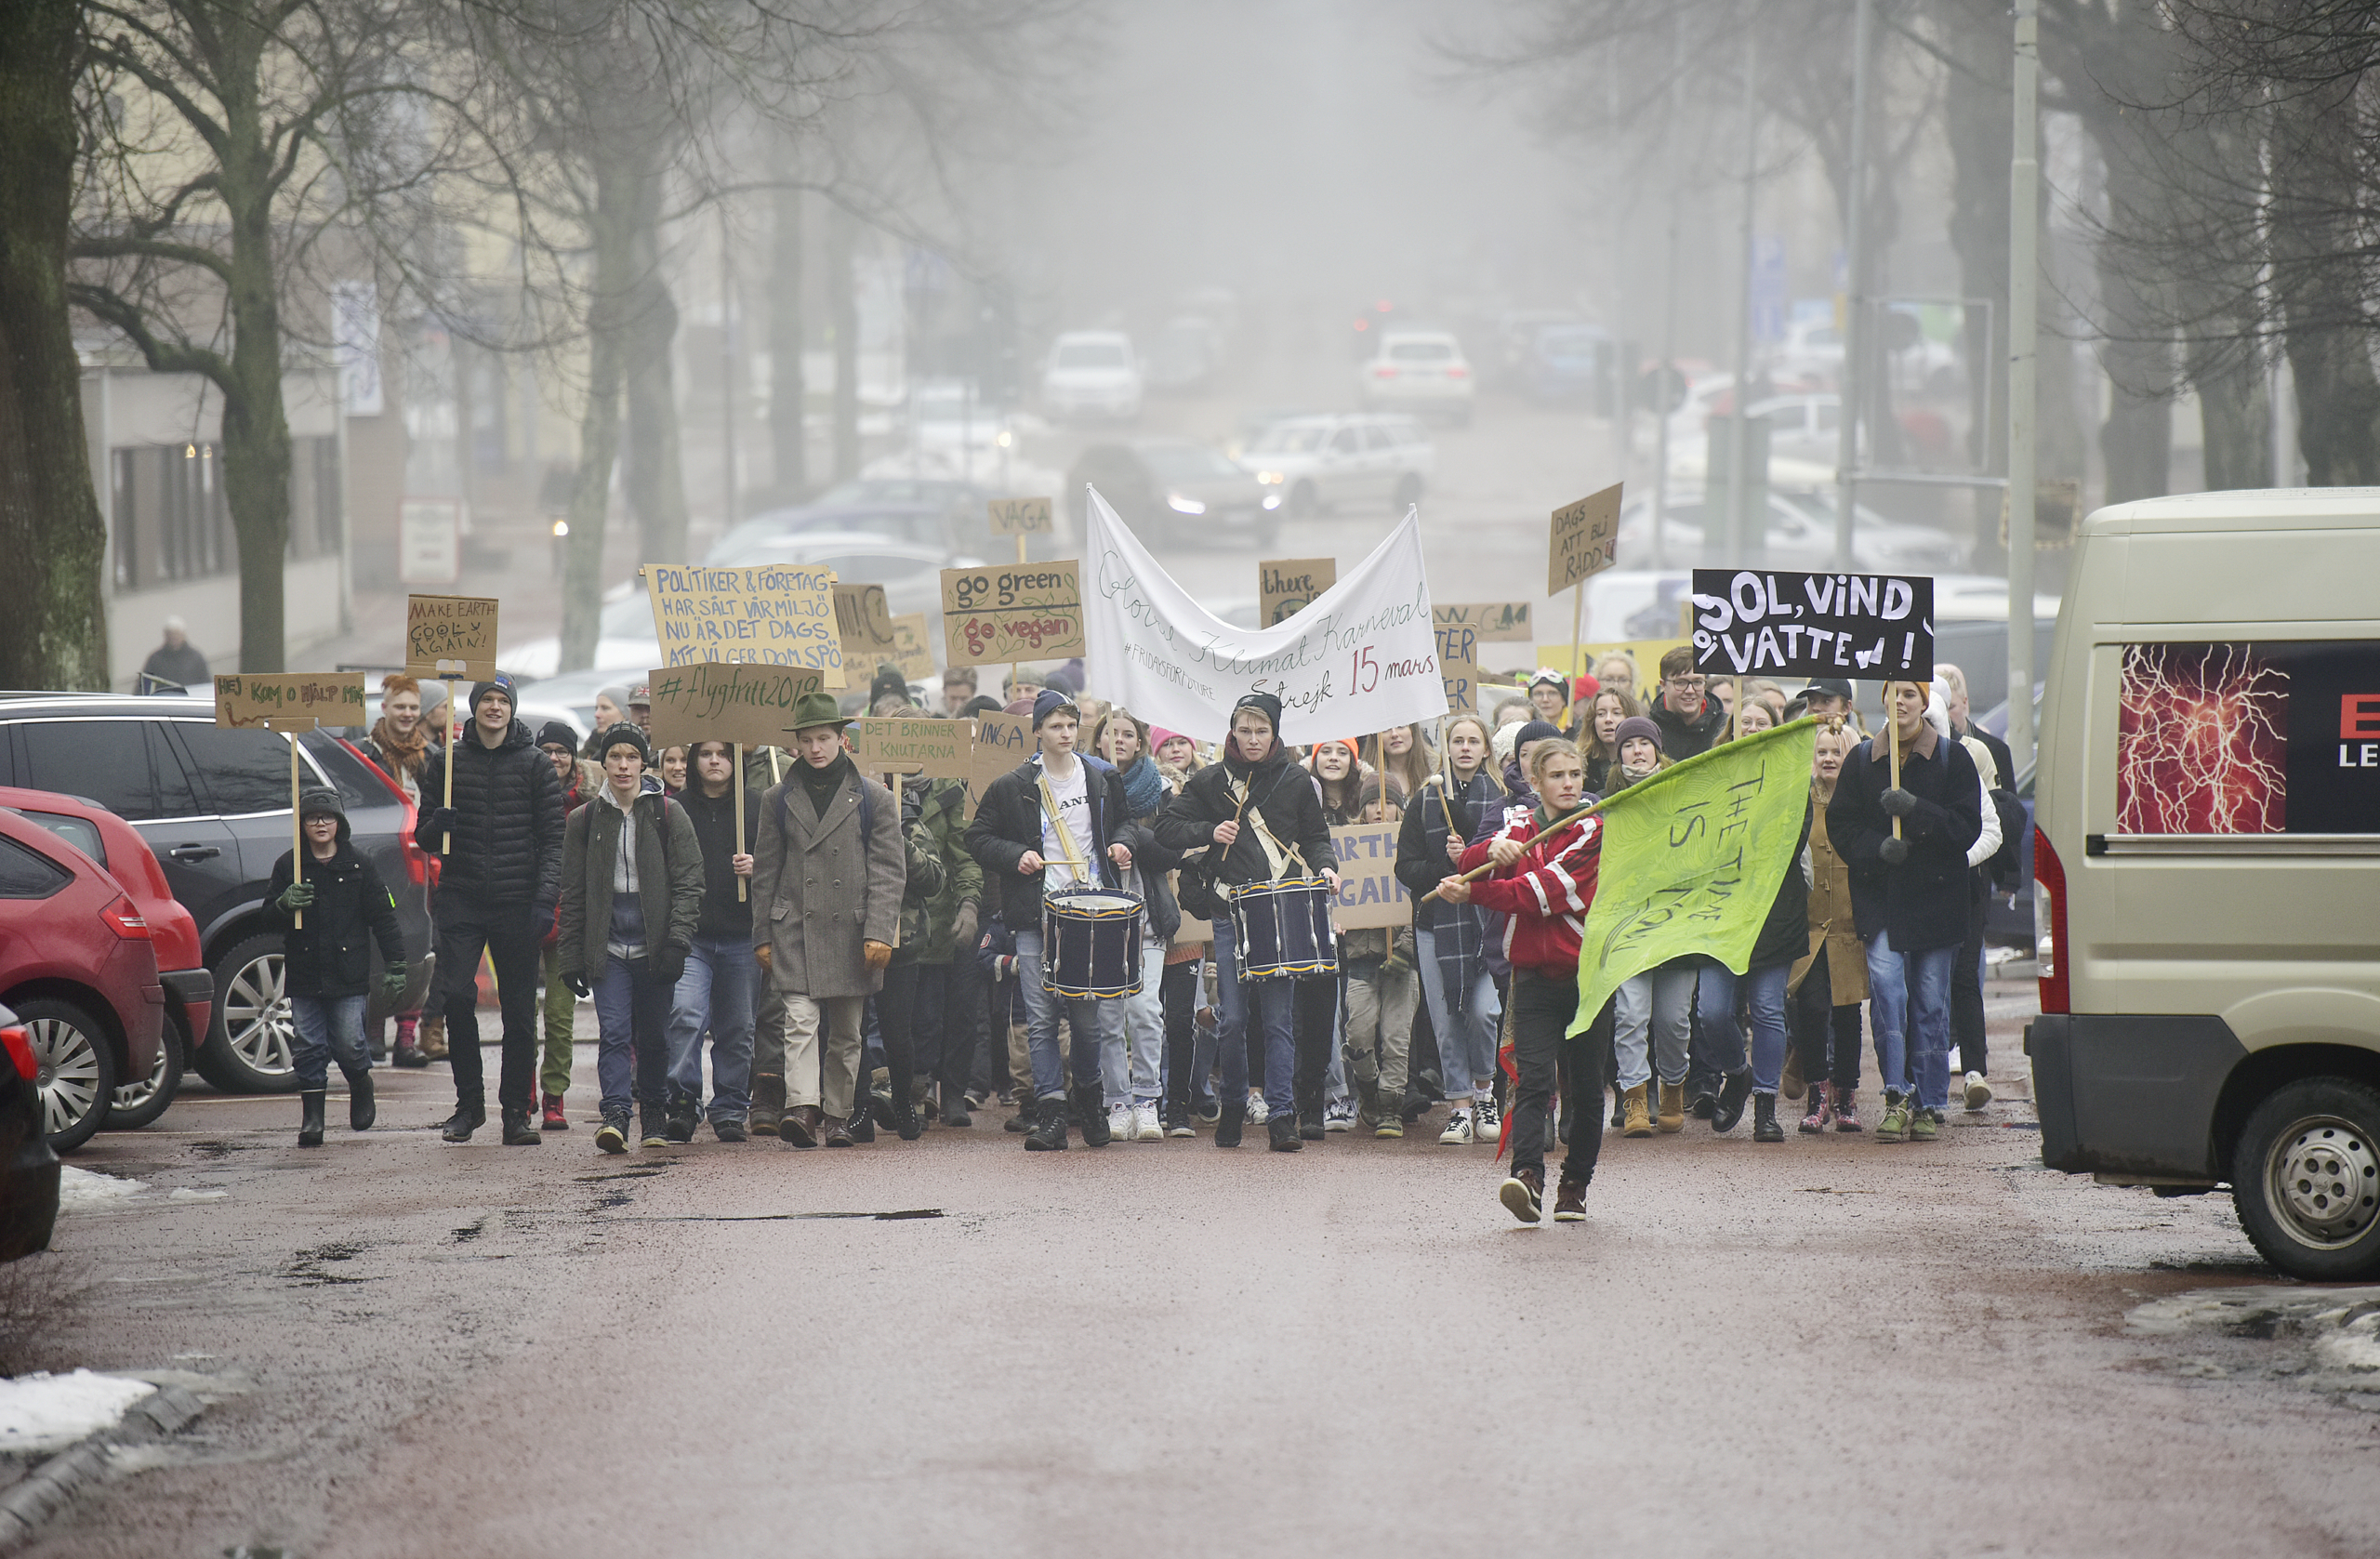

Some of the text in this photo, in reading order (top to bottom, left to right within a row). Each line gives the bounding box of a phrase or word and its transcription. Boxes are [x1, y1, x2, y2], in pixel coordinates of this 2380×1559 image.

[1556, 505, 1585, 535] DAGS
[1561, 530, 1584, 556] ATT
[746, 570, 757, 593] &
[758, 567, 828, 592] FÖRETAG
[957, 573, 1061, 609] go green
[1263, 569, 1315, 594] there
[409, 601, 496, 620] MAKE EARTH
[662, 598, 695, 617] HAR
[699, 596, 737, 616] SÅLT
[744, 596, 775, 619] VÅR
[1314, 580, 1429, 661] Karneval
[666, 616, 828, 641] NU ÄR DET DAGS
[964, 618, 995, 656] go
[1004, 618, 1068, 649] vegan
[669, 644, 696, 667] ATT
[726, 648, 756, 664] GER
[762, 647, 801, 665] DOM
[805, 640, 842, 668] SPÖ
[1350, 645, 1379, 696] 15
[1385, 654, 1435, 680] mars
[218, 677, 242, 696] HEJ
[251, 681, 282, 708] KOM
[287, 687, 296, 701] O
[300, 682, 338, 708] HJÄLP
[866, 722, 892, 736] DET
[981, 722, 1024, 749] INGA
[880, 743, 956, 760] KNUTARNA
[1670, 801, 1711, 847] IS
[1330, 833, 1397, 862] ARTH
[1688, 760, 1765, 920] THE TIME
